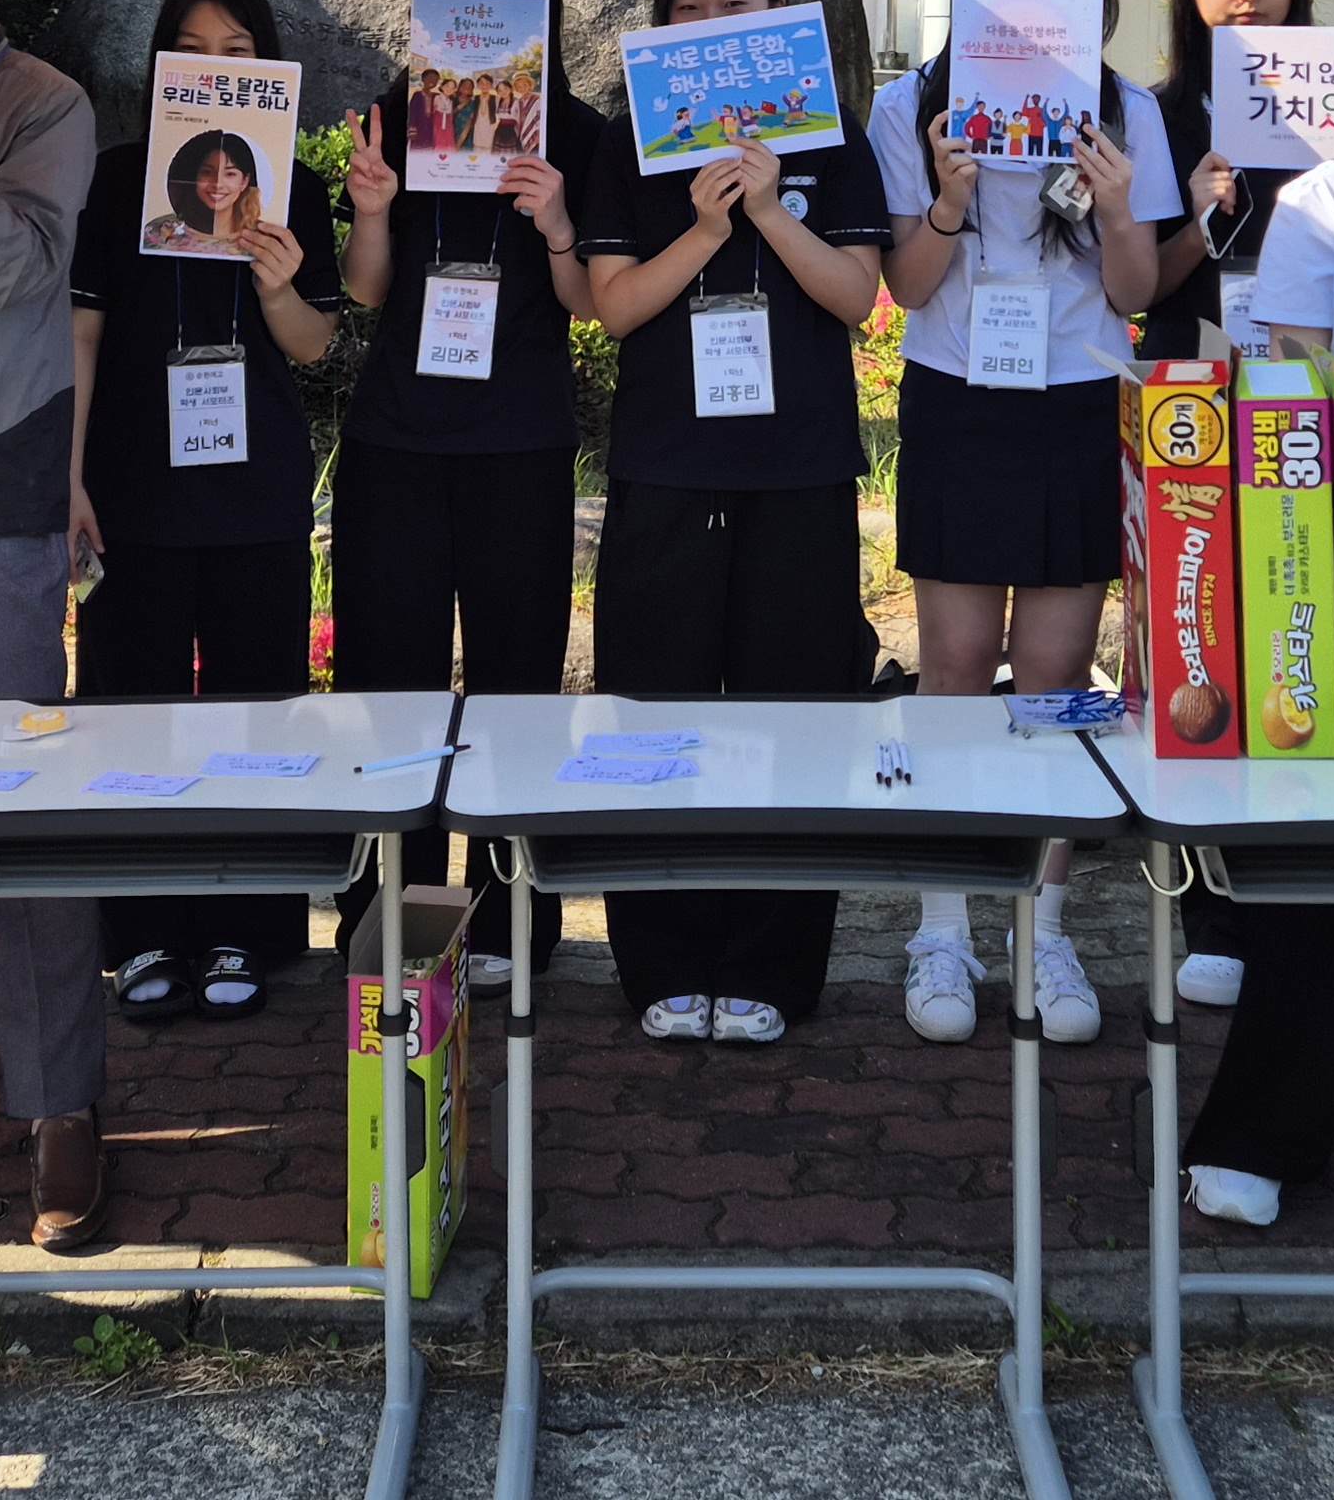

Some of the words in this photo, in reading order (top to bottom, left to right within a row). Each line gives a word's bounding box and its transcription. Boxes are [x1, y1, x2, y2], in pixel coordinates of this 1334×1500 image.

[464, 3, 495, 19] 다름은
[444, 31, 511, 50] 특별함입니다
[661, 45, 702, 70] 서로
[703, 37, 743, 65] 다른
[746, 33, 795, 62] 문화,
[960, 41, 992, 54] 세상을
[995, 43, 1015, 55] 보는
[986, 24, 1020, 38] 다름을
[1023, 25, 1067, 39] 인정하면
[164, 71, 230, 91] 피부색은
[237, 76, 286, 96] 달라도
[668, 71, 711, 96] 하나
[714, 61, 752, 90] 되는
[756, 56, 796, 84] 우리
[1242, 52, 1310, 86] 같지
[162, 86, 212, 106] 우리는
[218, 92, 251, 109] 모두
[257, 95, 290, 112] 하나
[431, 346, 480, 365] 김민주
[184, 432, 234, 452] 선나예
[1169, 402, 1198, 459] 30개
[1253, 410, 1280, 486] 가성비
[1281, 410, 1322, 488] 30개
[1157, 478, 1224, 522] 情
[1281, 494, 1294, 541] 부드러운
[1298, 524, 1309, 567] 카스타드
[1173, 526, 1211, 626] 초코파이
[1201, 573, 1216, 606] 1974
[1203, 607, 1218, 647] SINCE
[1178, 629, 1210, 687] 오리온
[1272, 630, 1283, 670] 오리온
[1286, 601, 1316, 711] 카스타드
